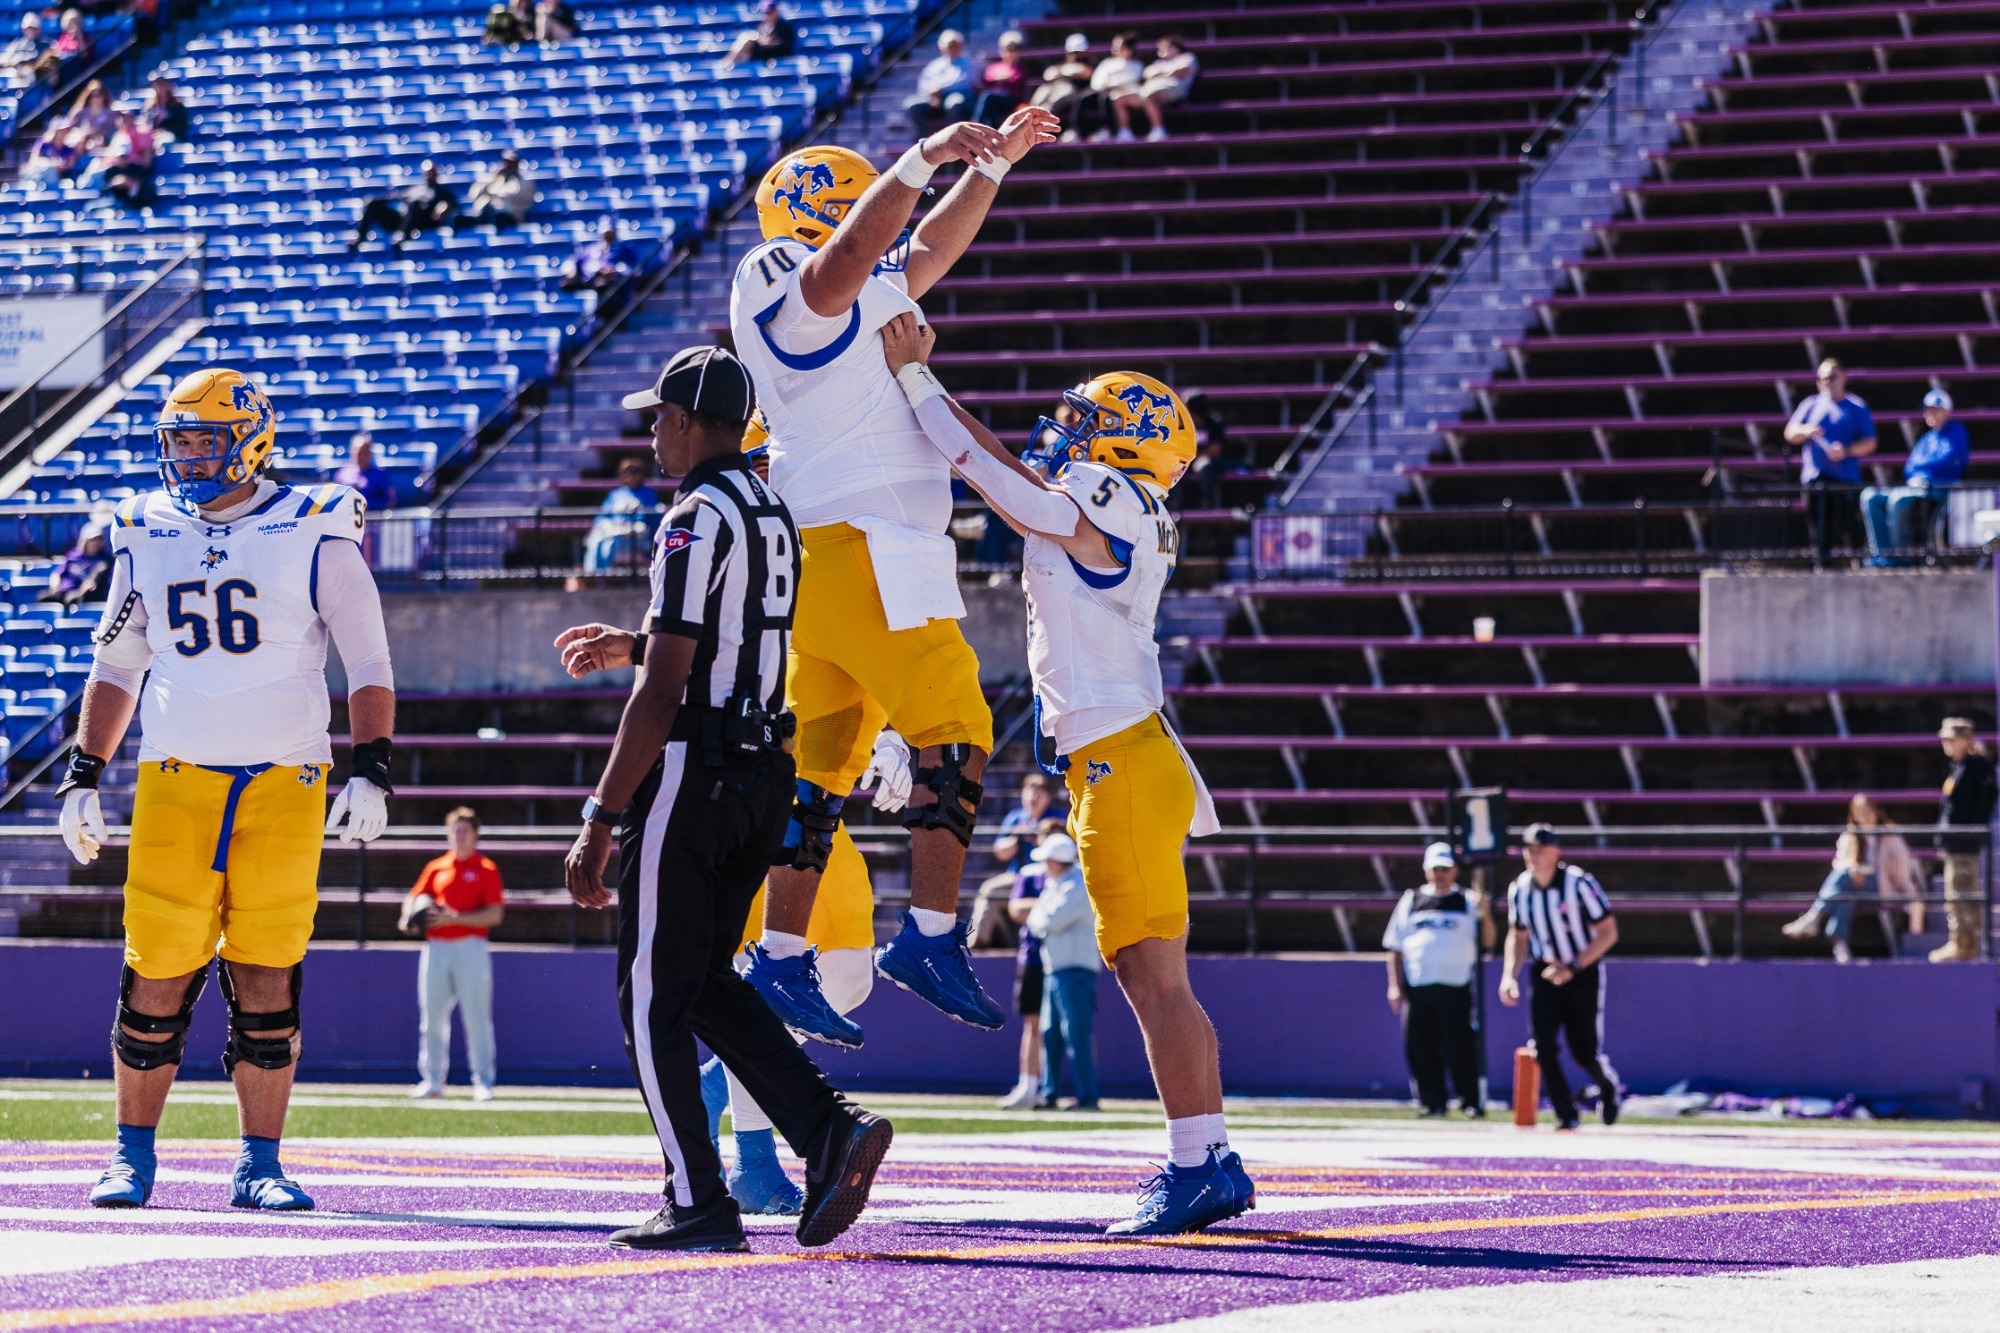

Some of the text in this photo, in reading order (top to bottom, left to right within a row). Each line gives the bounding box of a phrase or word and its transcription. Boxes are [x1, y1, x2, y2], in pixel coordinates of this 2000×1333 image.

[353, 497, 366, 530] 5
[1091, 475, 1121, 509] 5
[257, 521, 299, 532] NAVARRE
[756, 516, 794, 617] B
[167, 578, 263, 659] 56
[1465, 798, 1495, 850] 1
